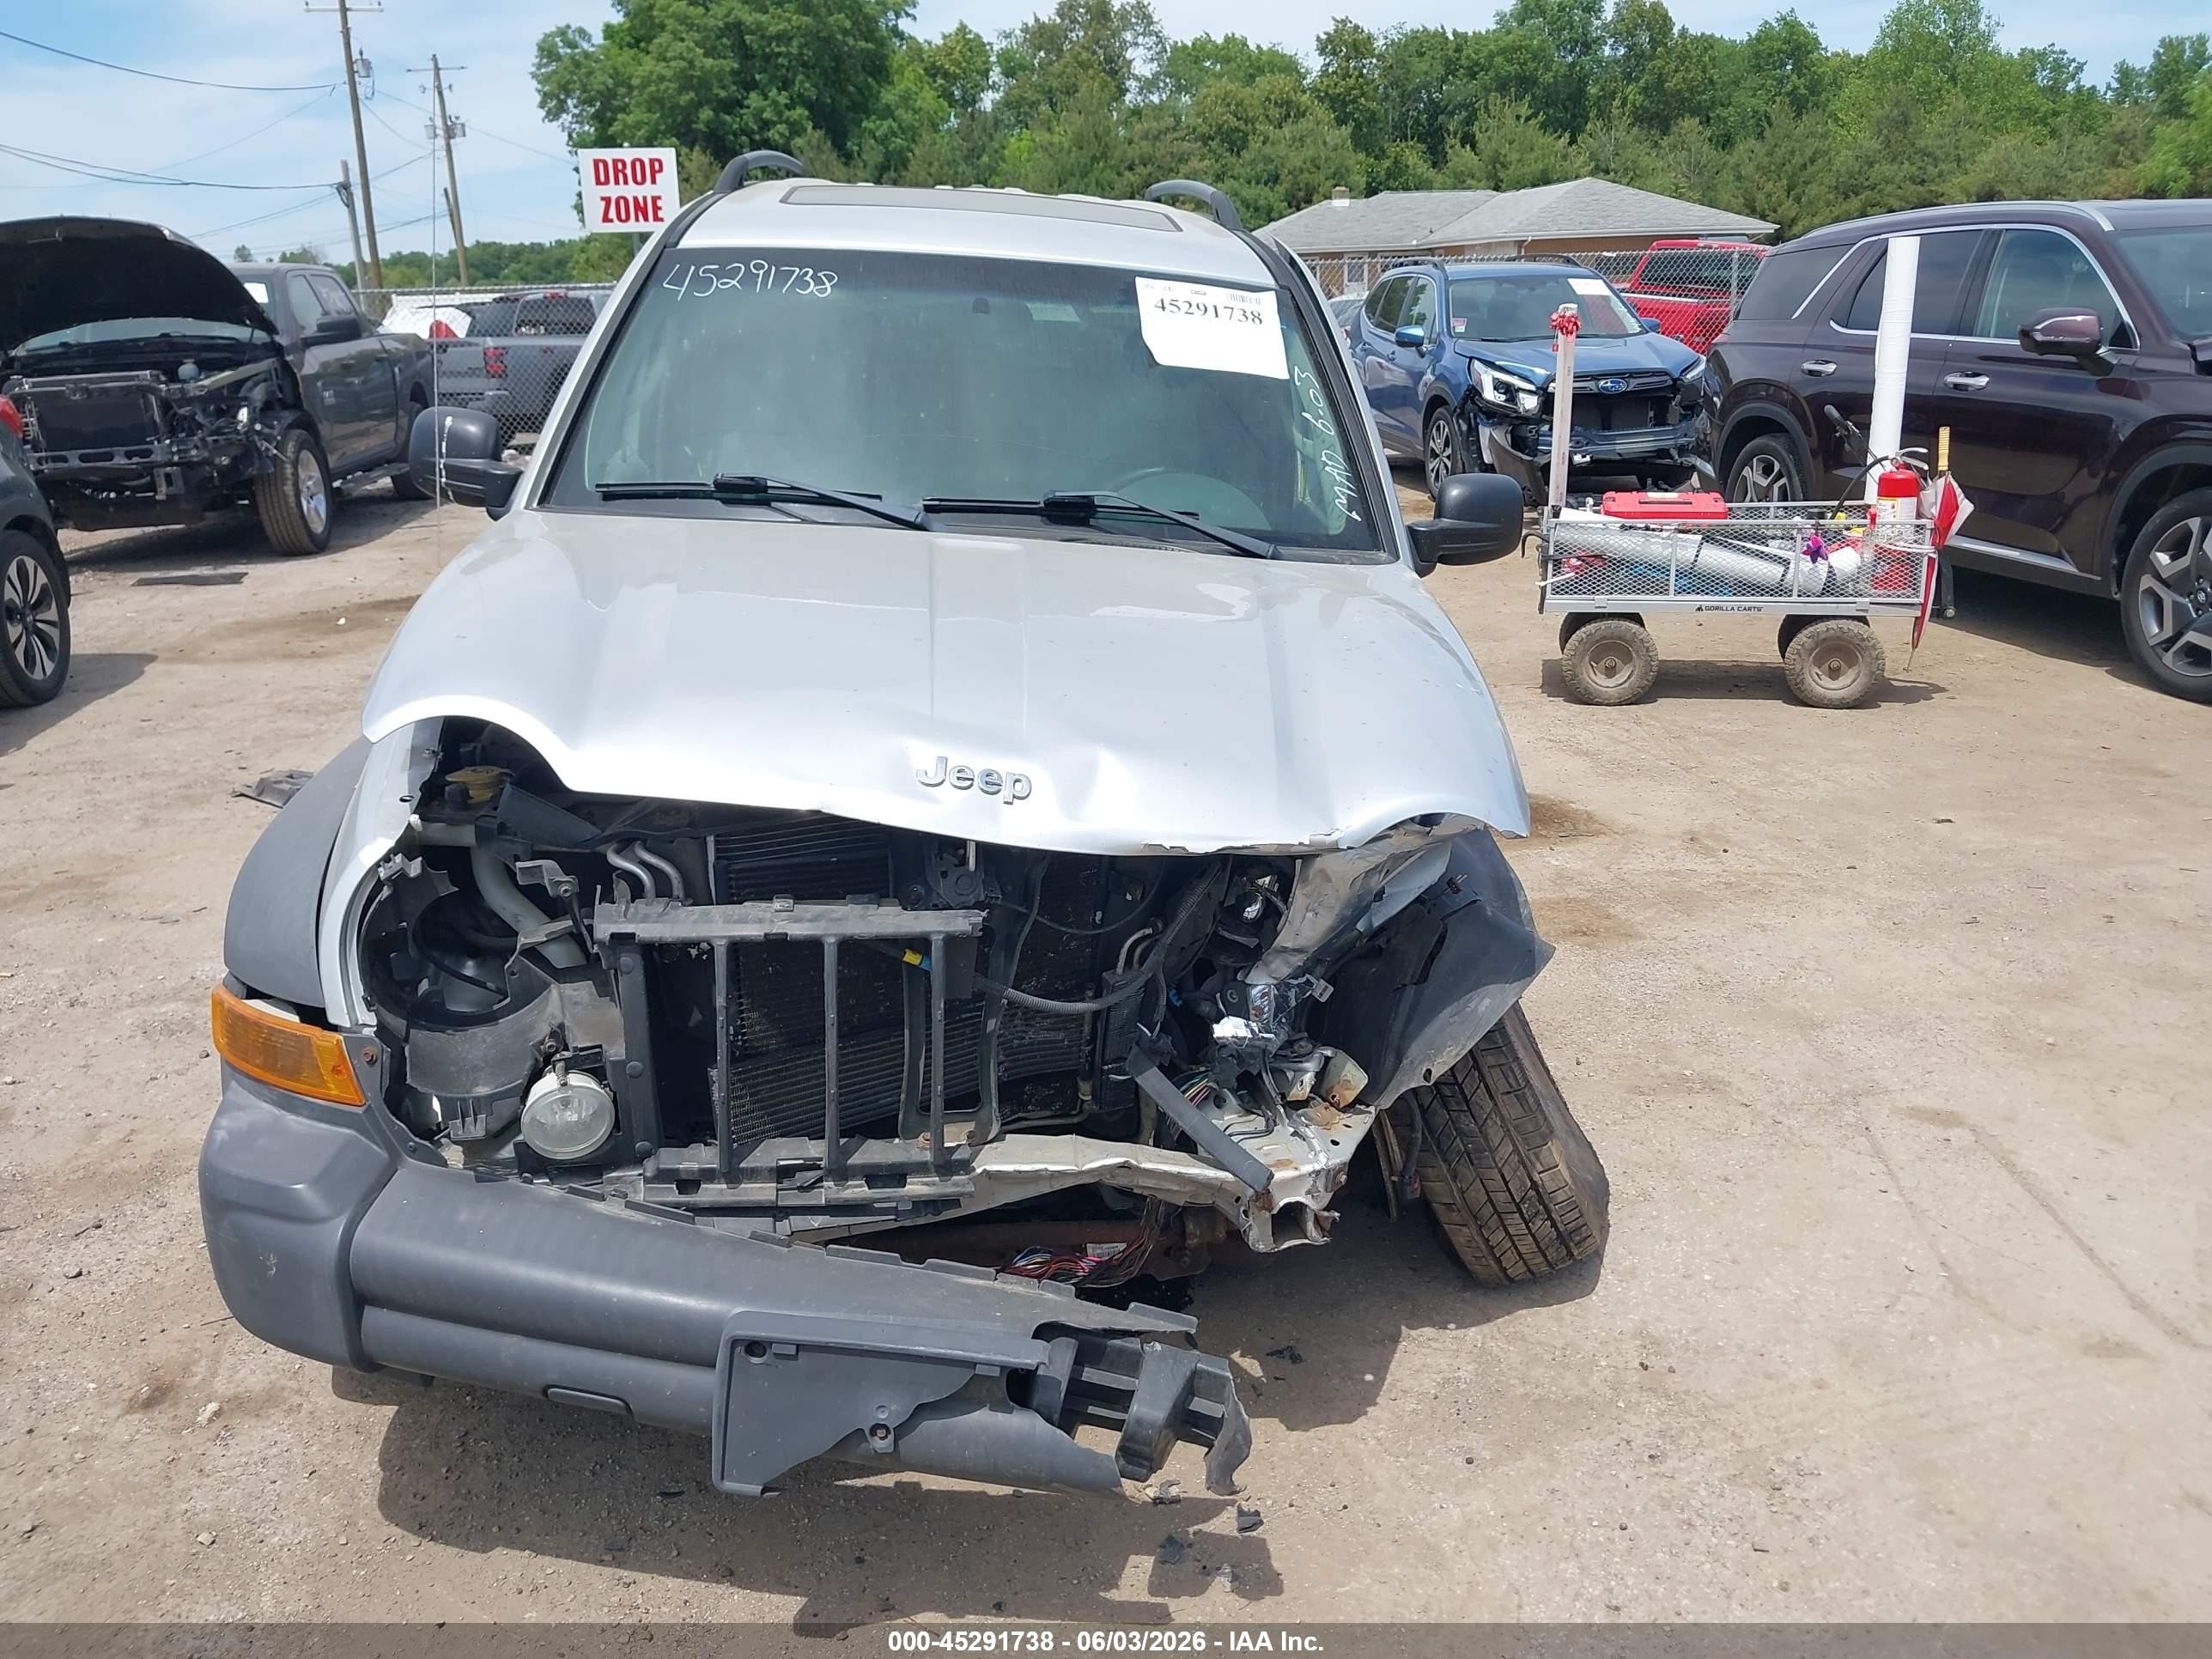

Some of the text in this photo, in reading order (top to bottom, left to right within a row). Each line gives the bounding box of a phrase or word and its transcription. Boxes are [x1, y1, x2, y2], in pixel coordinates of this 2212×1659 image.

[592, 157, 664, 186] DROP
[599, 195, 665, 223] ZONE
[662, 259, 839, 301] 45291738
[1154, 297, 1263, 325] 45291738
[915, 756, 1032, 805] Jeep
